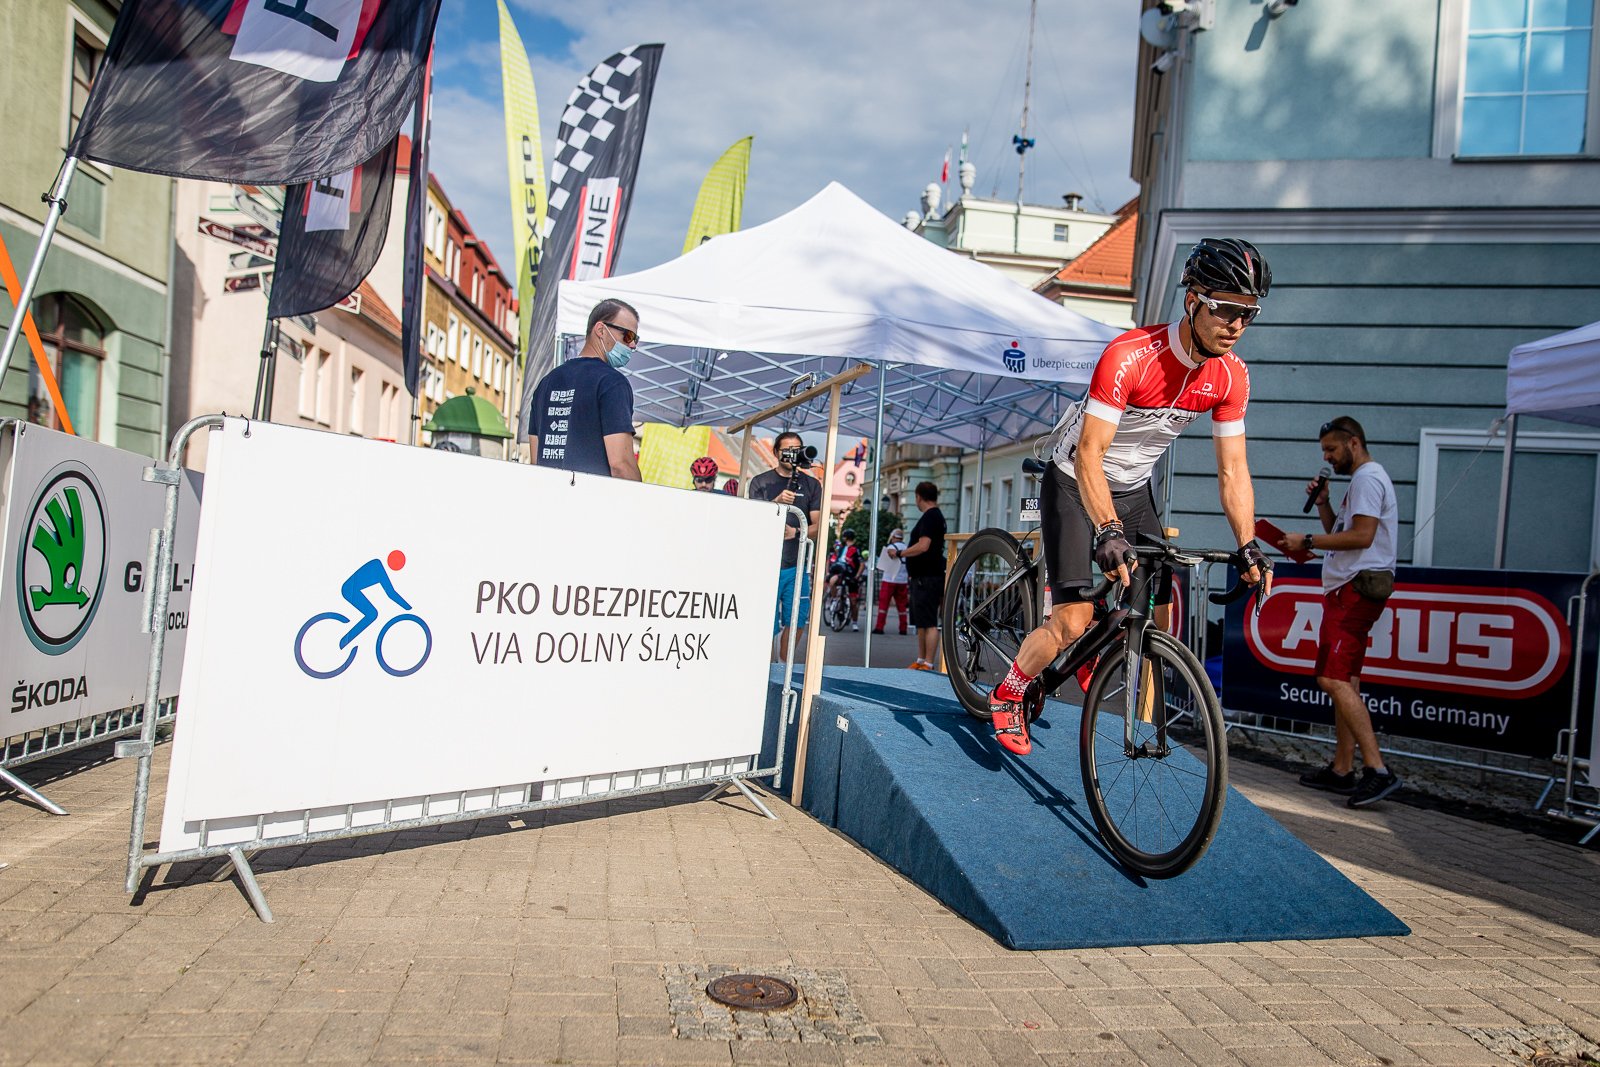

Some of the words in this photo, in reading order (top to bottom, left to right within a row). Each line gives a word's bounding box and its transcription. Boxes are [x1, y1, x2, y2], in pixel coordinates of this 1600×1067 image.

[582, 194, 611, 267] LINE
[1032, 358, 1096, 371] Ubezpieczeni
[1112, 339, 1163, 404] DANIELO
[543, 448, 565, 456] BIKE
[1025, 498, 1039, 510] 593
[124, 560, 195, 592] GL-
[475, 580, 541, 615] PKO
[552, 584, 739, 620] UBEZPIECZENIA
[470, 631, 523, 665] VIA
[535, 632, 633, 664] DOLNY
[638, 626, 711, 670] ŚLĄSK
[10, 675, 88, 714] ŠKODA
[1279, 682, 1333, 706] Securi
[1360, 692, 1402, 717] Tech
[1410, 699, 1510, 735] Germany
